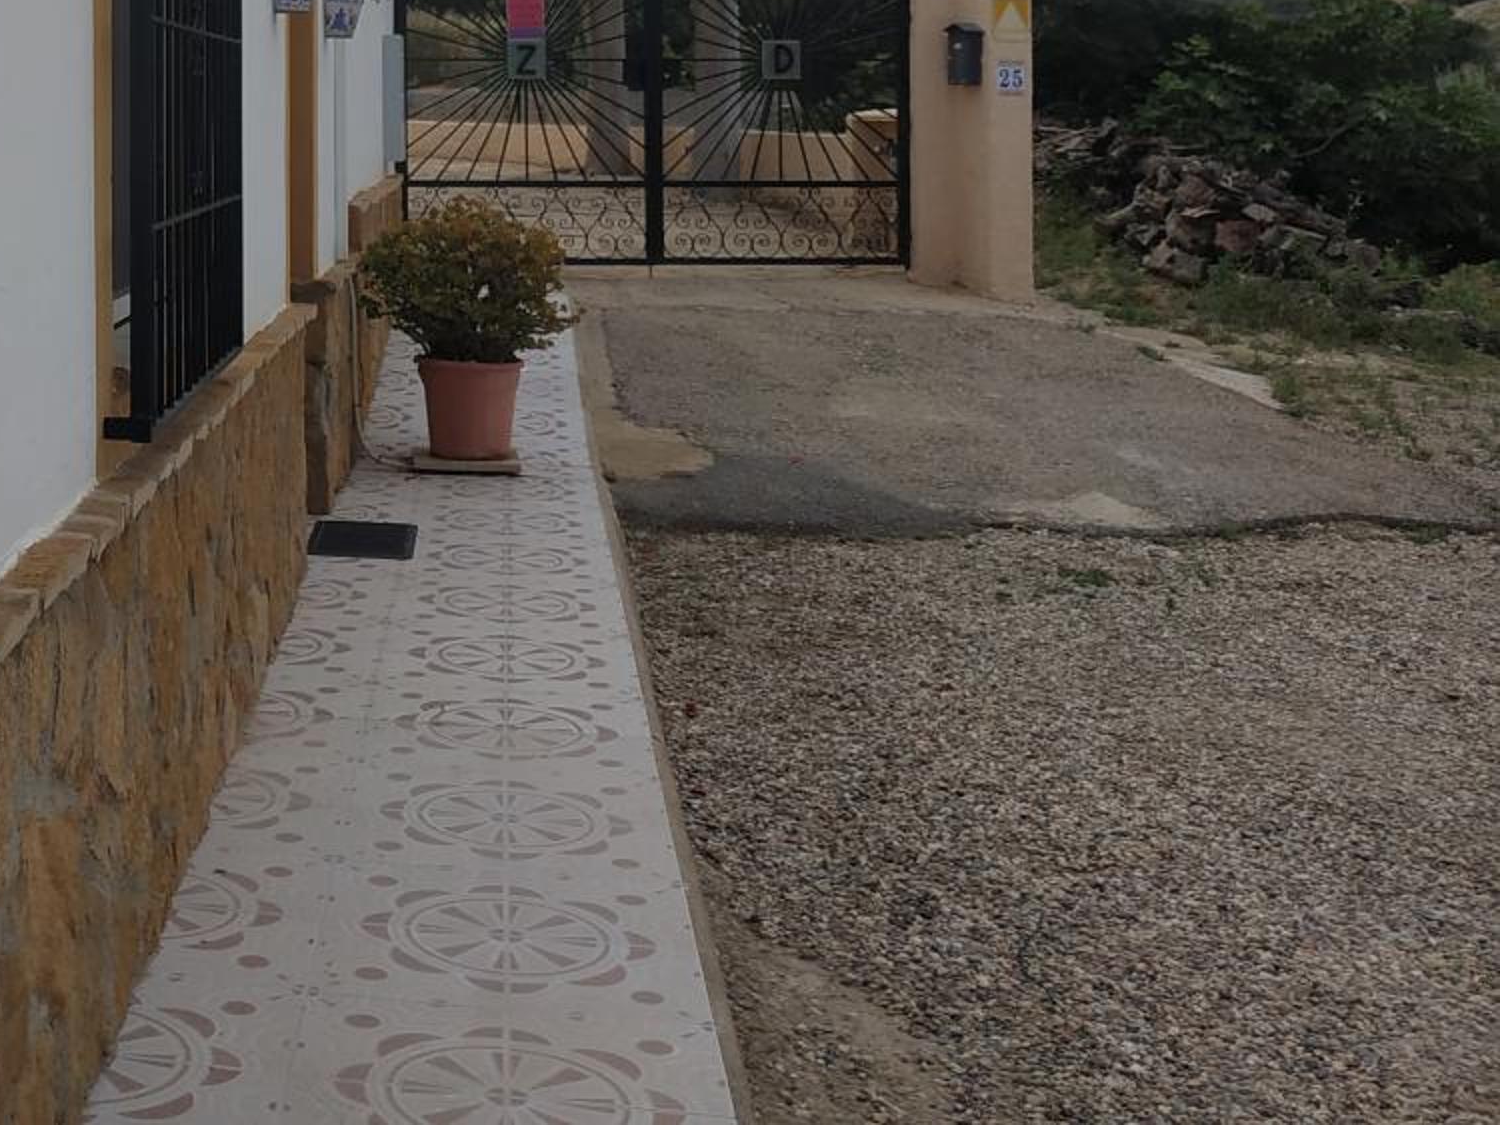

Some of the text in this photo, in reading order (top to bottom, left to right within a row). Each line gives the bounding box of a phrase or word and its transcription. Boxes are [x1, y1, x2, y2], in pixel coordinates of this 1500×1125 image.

[516, 43, 537, 75] Z
[773, 45, 795, 74] D
[1000, 69, 1023, 88] 25
